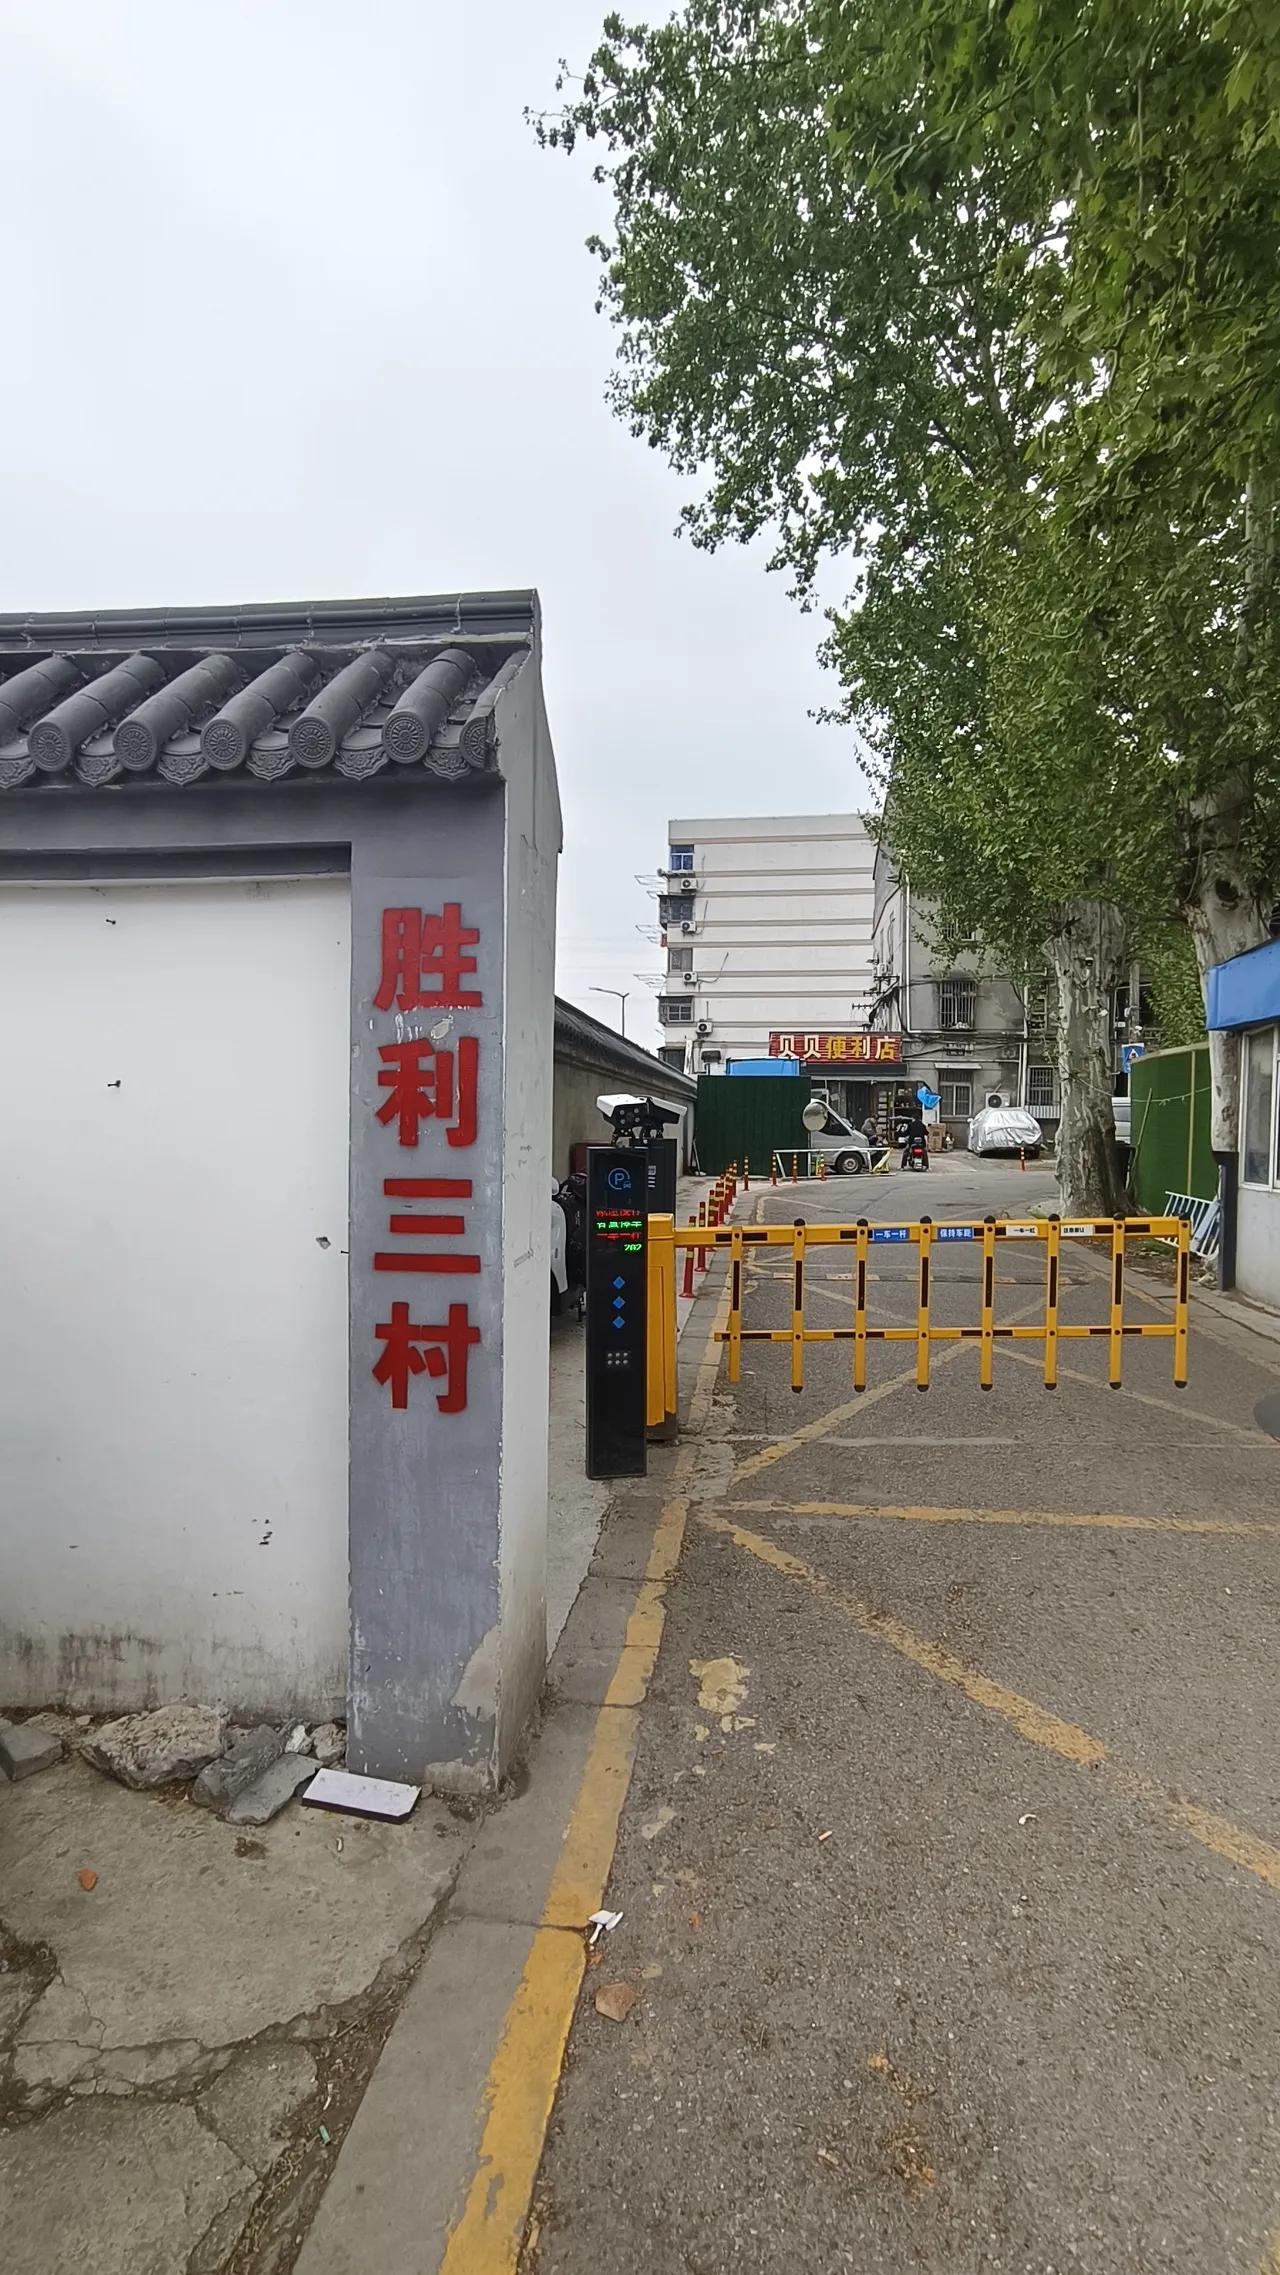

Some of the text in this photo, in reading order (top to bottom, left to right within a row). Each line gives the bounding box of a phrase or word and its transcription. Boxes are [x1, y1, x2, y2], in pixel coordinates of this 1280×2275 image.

[777, 1034, 897, 1061] 贝贝便利店
[373, 902, 484, 1413] 胜利三村
[875, 1229, 907, 1239] 一车一杆
